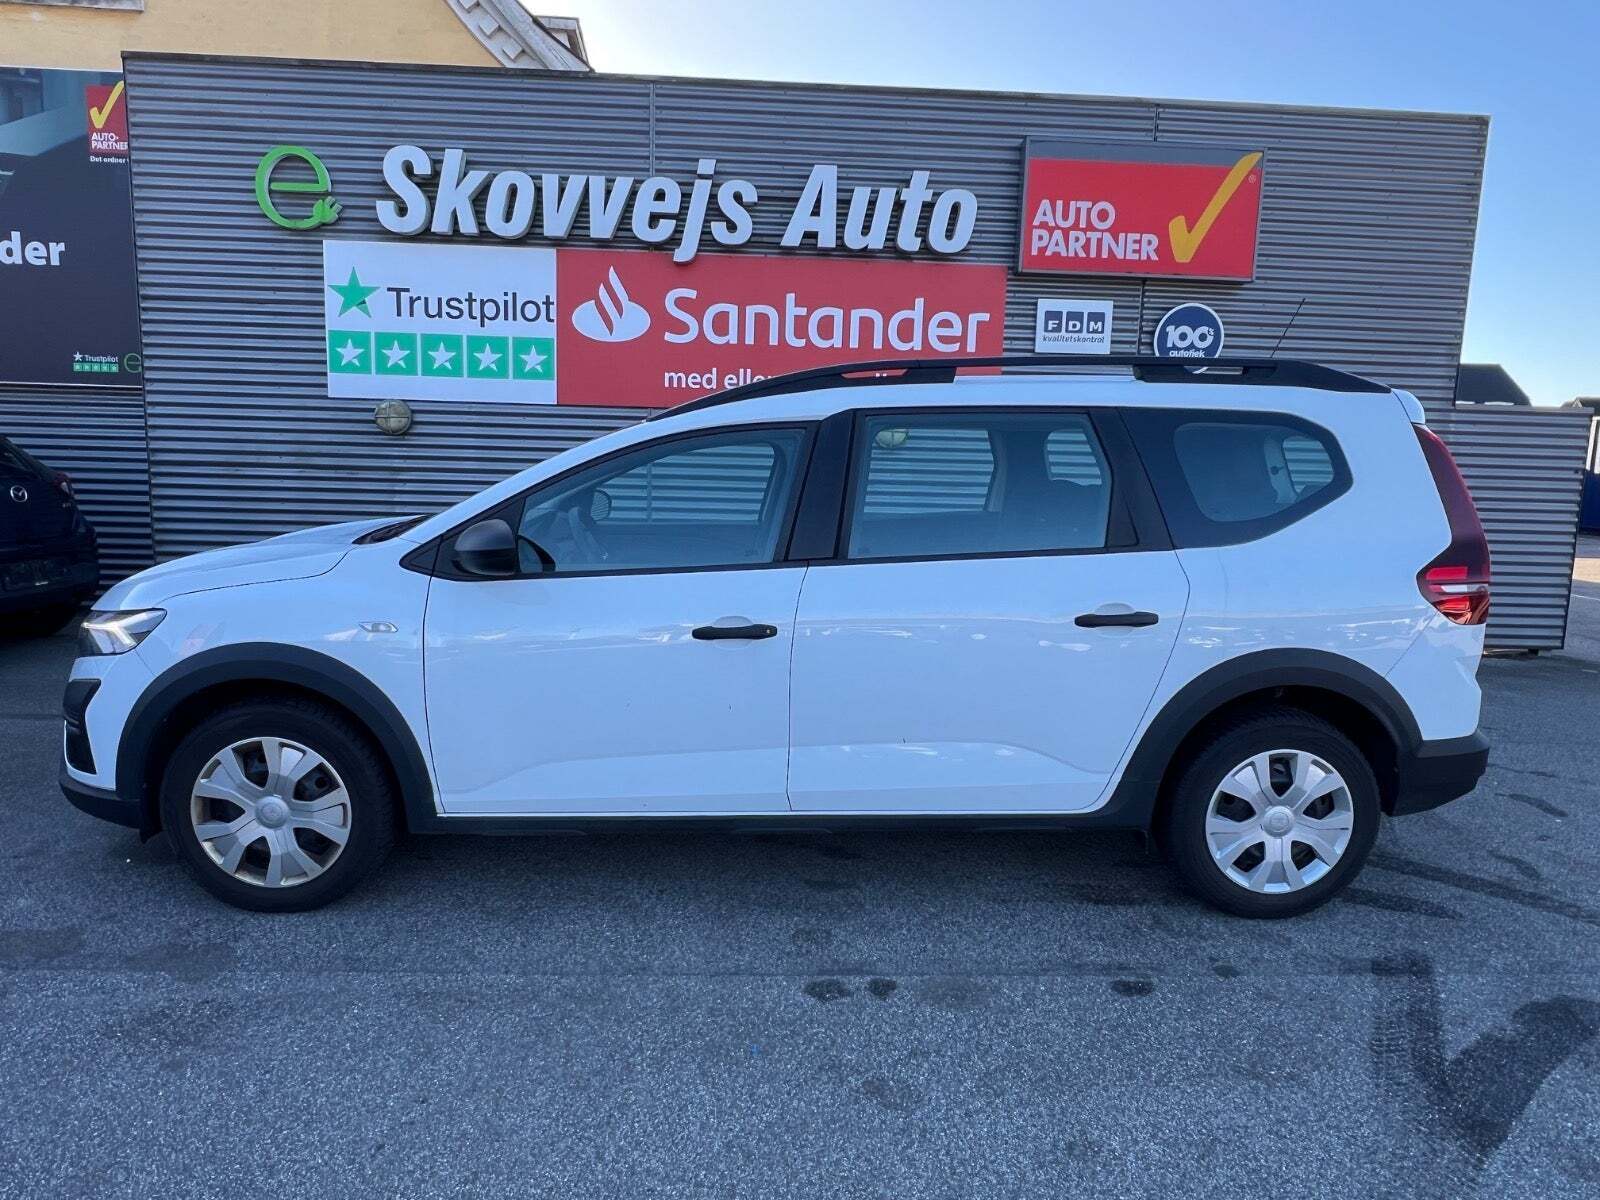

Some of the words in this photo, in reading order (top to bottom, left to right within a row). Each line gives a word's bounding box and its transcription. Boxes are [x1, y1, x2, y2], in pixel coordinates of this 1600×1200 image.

[376, 145, 758, 264] Skovvejs
[780, 164, 978, 254] Auto
[1032, 199, 1116, 230] AUTO
[1031, 229, 1159, 261] PARTNER
[386, 287, 555, 328] Trustpilot
[664, 287, 991, 353] Santander
[1042, 335, 1105, 344] kvalitetskontrol
[83, 354, 119, 363] Trustpilot
[664, 367, 717, 389] med
[724, 368, 775, 389] ell
